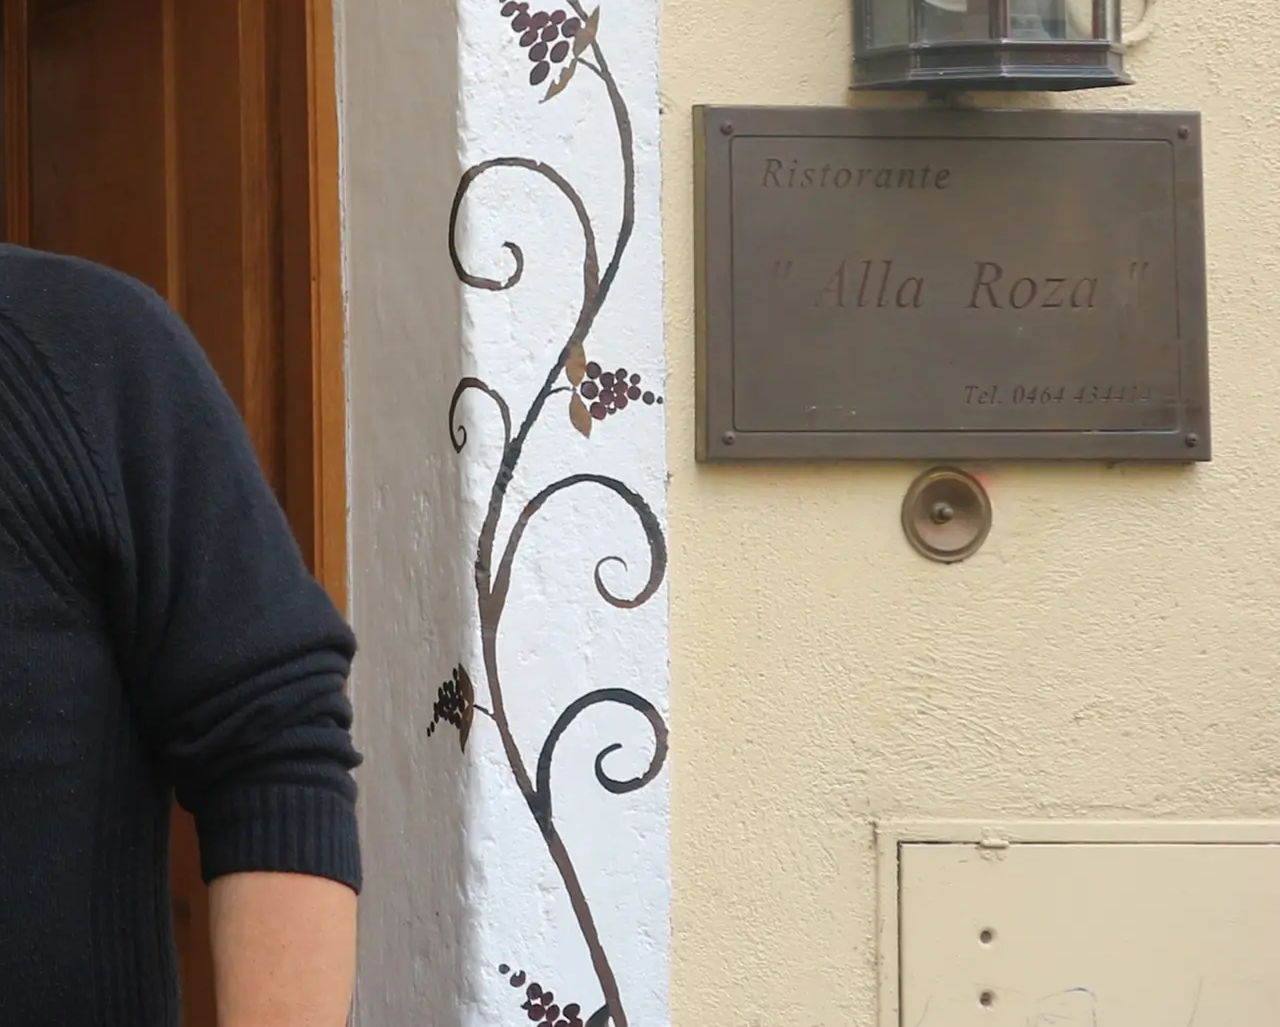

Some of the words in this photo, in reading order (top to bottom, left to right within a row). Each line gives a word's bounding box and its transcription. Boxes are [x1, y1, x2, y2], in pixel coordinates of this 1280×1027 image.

[760, 158, 952, 190] Ristorante
[964, 384, 1002, 405] Tel.
[1011, 384, 1065, 405] 0464
